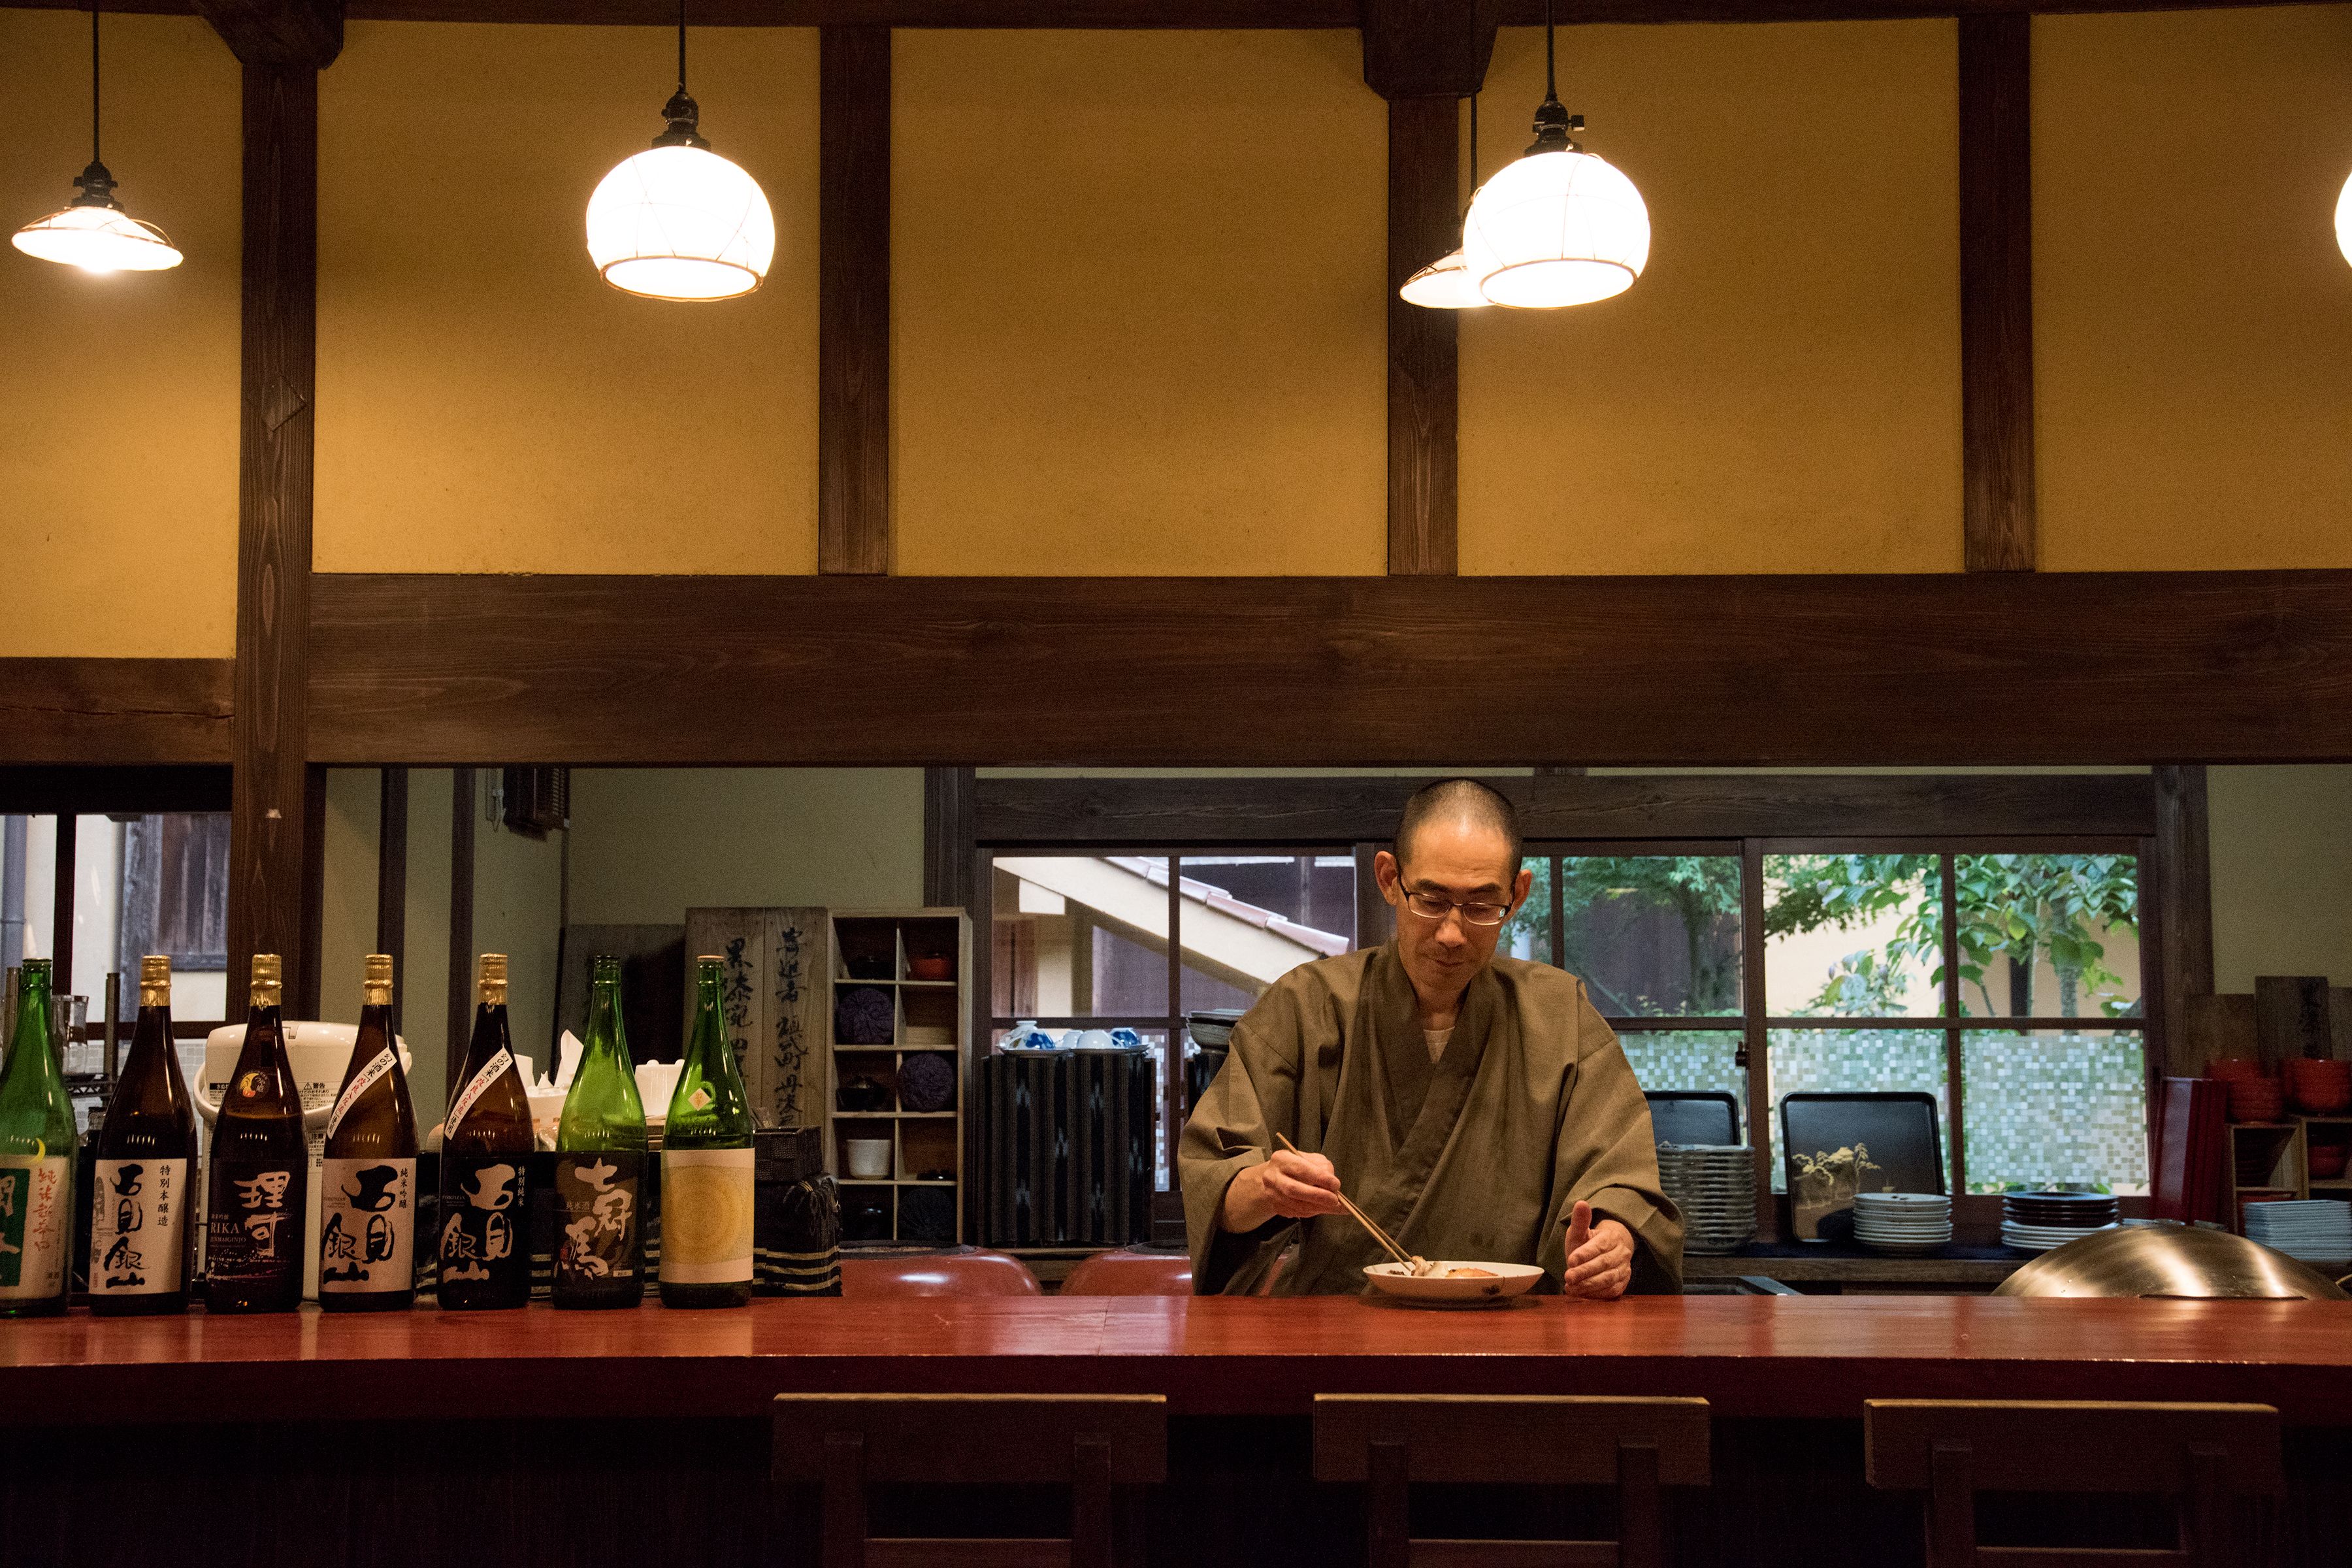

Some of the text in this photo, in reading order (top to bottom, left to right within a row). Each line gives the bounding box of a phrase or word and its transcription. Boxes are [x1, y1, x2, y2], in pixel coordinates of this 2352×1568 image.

[157, 1165, 171, 1226] 特別本醸造
[399, 1168, 408, 1209] 純米吟醸
[517, 1166, 526, 1207] 特別純米
[210, 1222, 240, 1234] RIKA
